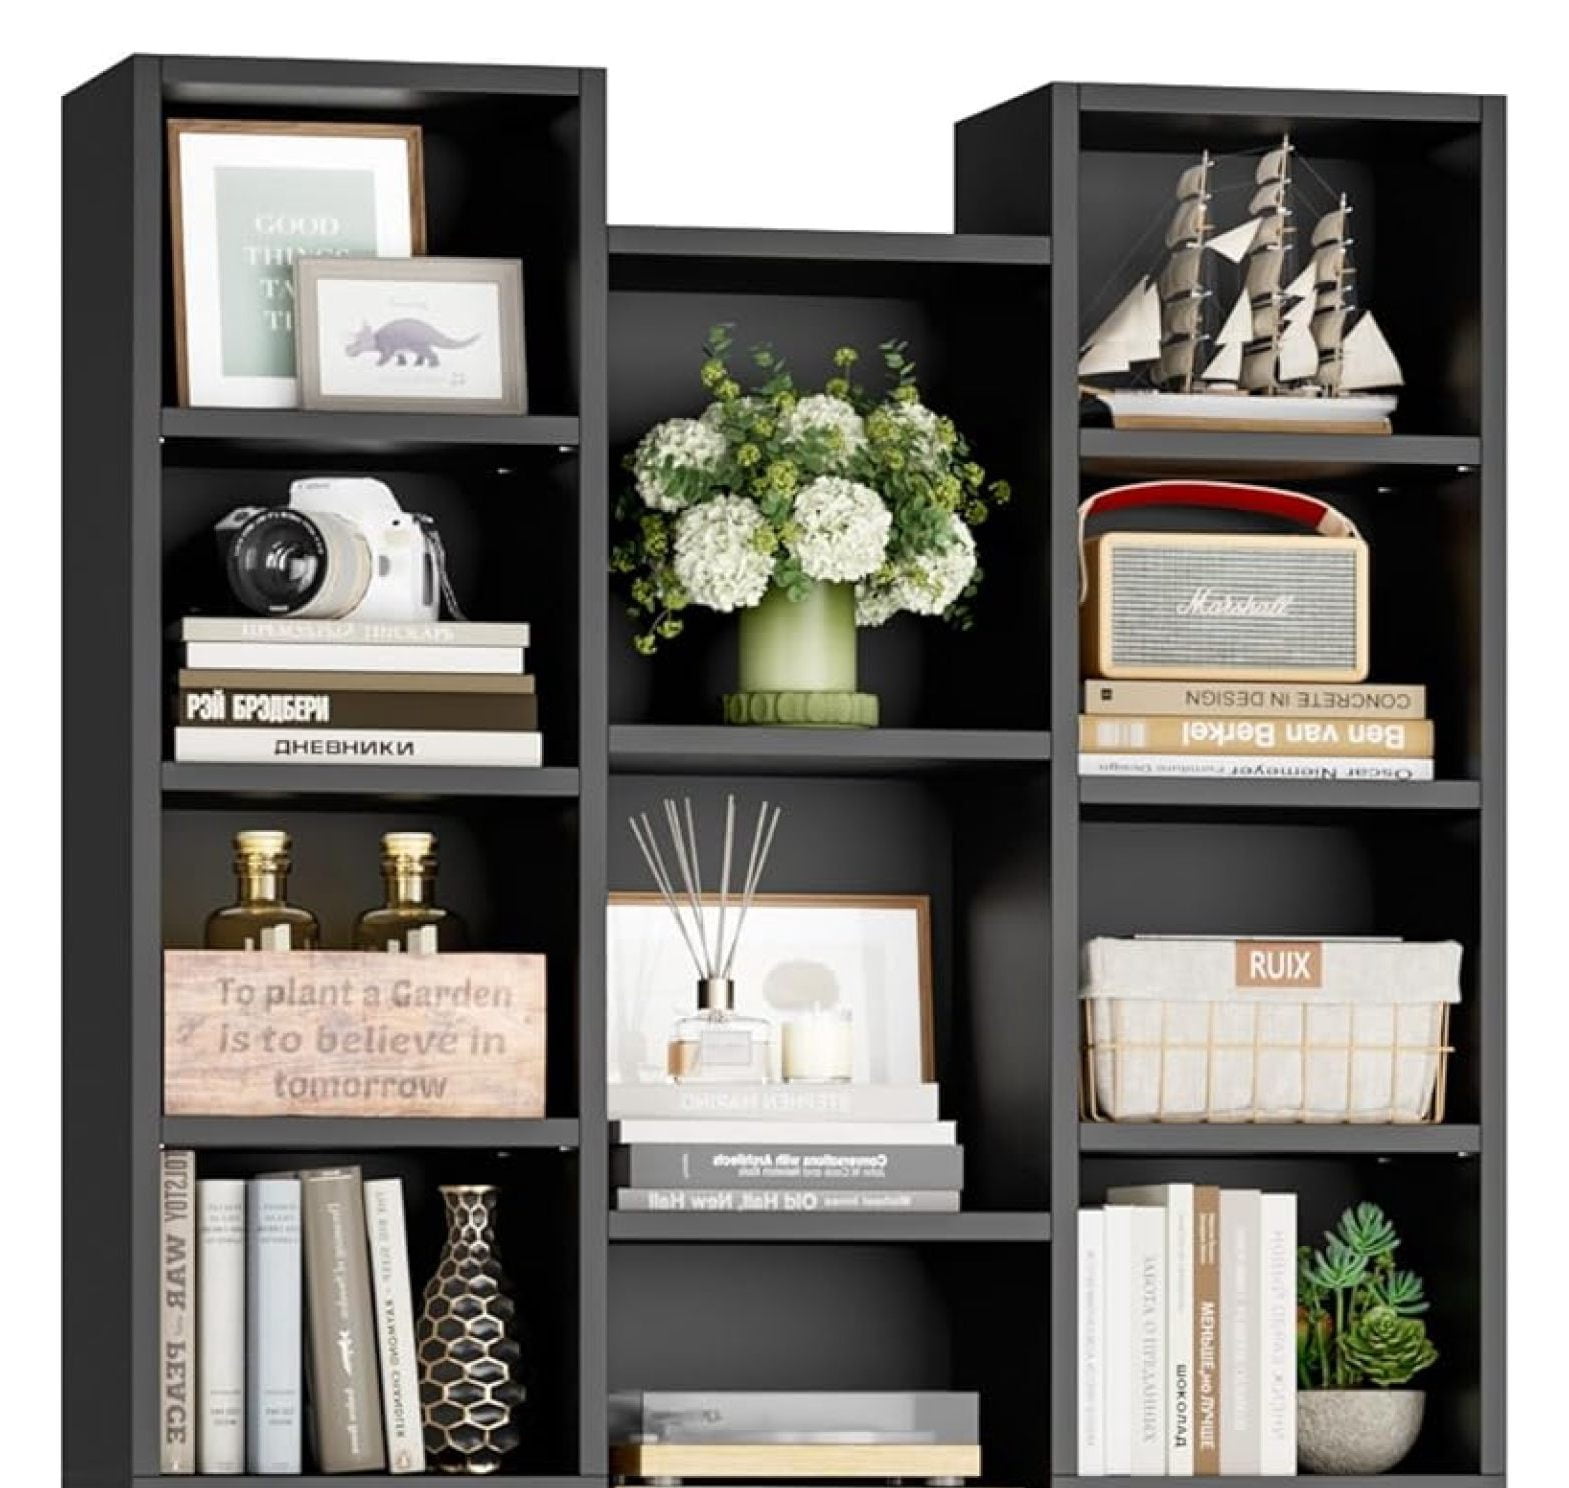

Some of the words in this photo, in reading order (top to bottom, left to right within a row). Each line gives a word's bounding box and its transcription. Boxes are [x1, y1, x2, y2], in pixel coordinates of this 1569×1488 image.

[254, 216, 341, 236] GOOD
[1176, 587, 1295, 617] Marshall
[187, 689, 225, 720] РЭЙ
[231, 694, 330, 724] БРЭДБЕРИ
[1185, 688, 1265, 708] DESIGN
[1270, 690, 1292, 709] IN
[1297, 690, 1412, 711] CONCRETE
[1182, 721, 1276, 749] Berkel
[1286, 722, 1338, 745] van
[1348, 723, 1406, 750] Ben
[273, 738, 415, 757] ДНЕВНИКИ
[1346, 766, 1415, 780] Oscar
[1249, 950, 1312, 981] RUIX
[216, 977, 256, 1007] To
[265, 977, 354, 1014] plant
[363, 984, 382, 1008] a
[391, 977, 513, 1008] Garden
[218, 1024, 250, 1055] is
[264, 1026, 302, 1055] to
[316, 1024, 459, 1056] believe
[470, 1025, 508, 1056] in
[273, 1071, 449, 1100] tomorrow
[1174, 1363, 1188, 1449] ШОКОЛАД
